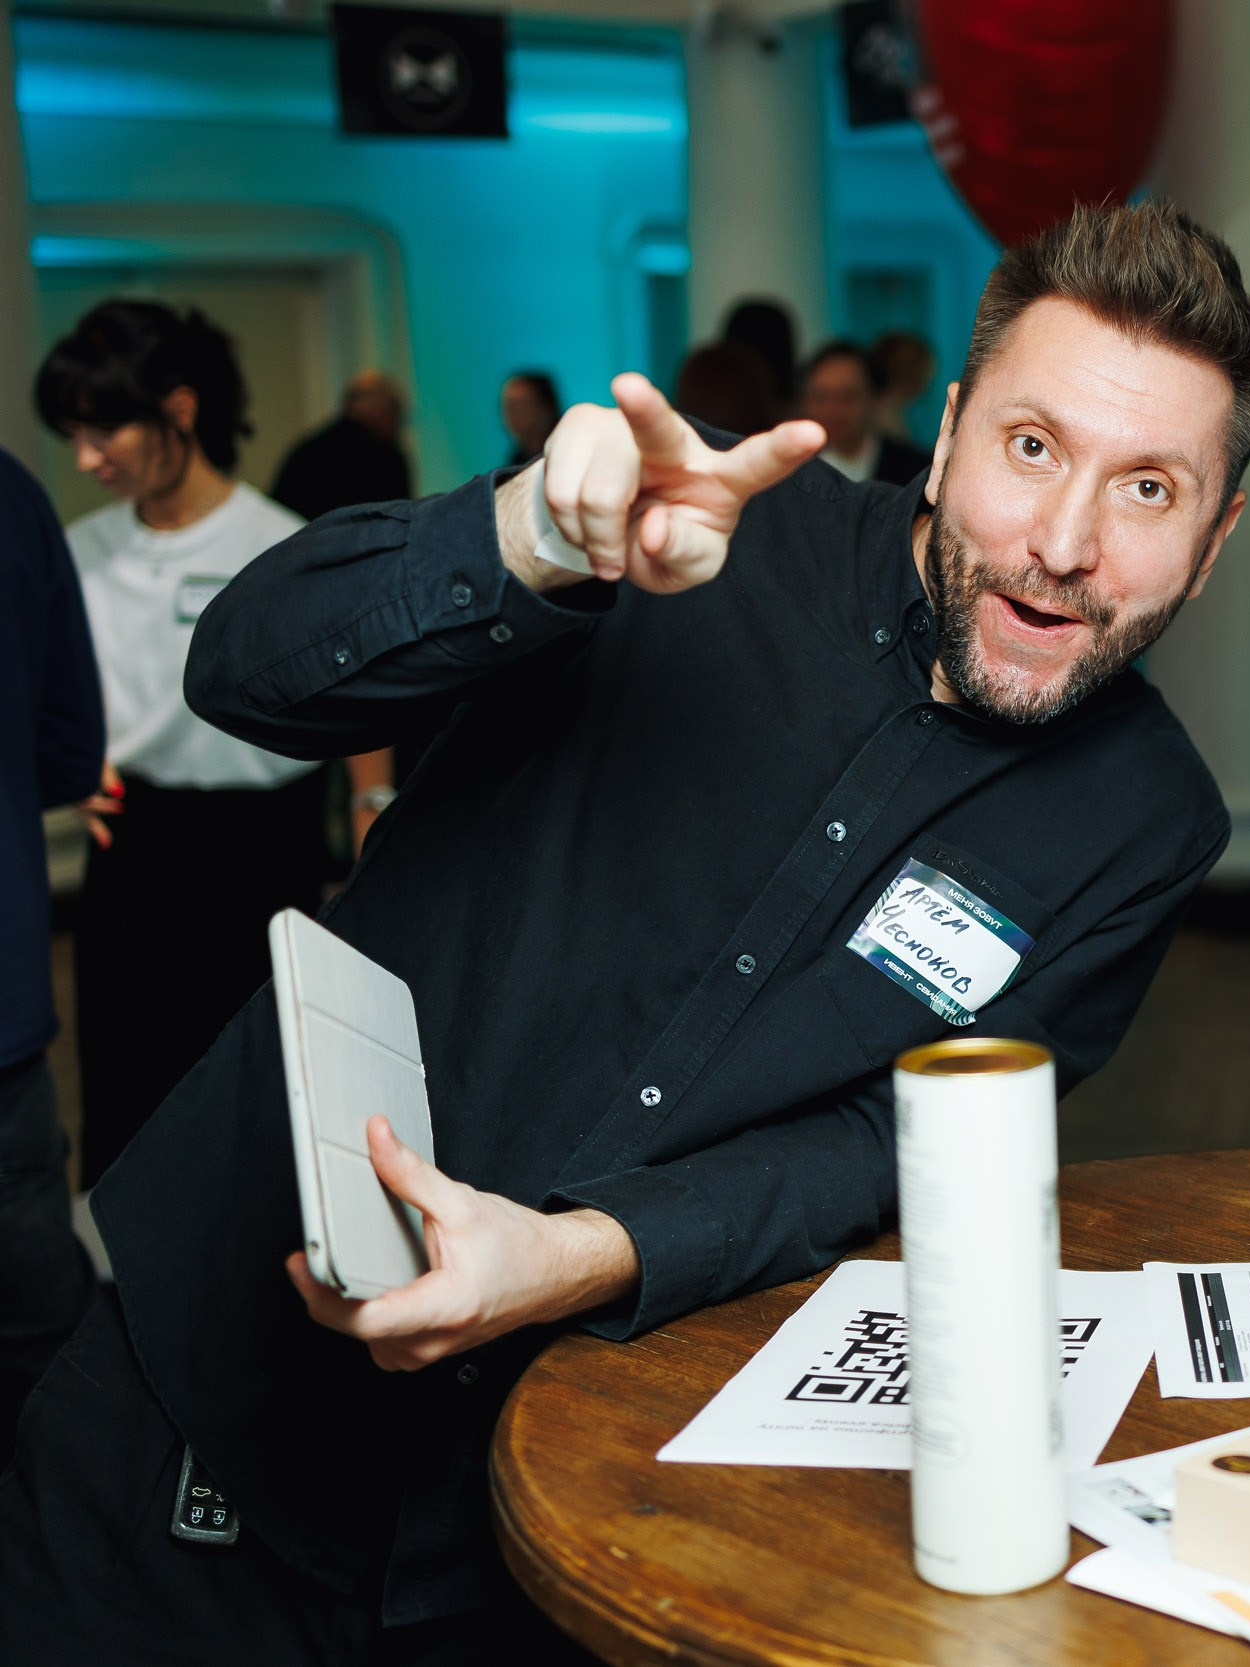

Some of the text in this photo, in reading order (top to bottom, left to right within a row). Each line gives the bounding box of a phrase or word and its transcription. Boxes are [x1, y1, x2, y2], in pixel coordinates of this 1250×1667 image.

[948, 888, 1003, 930] МЕНЯ ЗОВУТ
[884, 958, 958, 1016] ИВЕНТ СВИДАНИЯ
